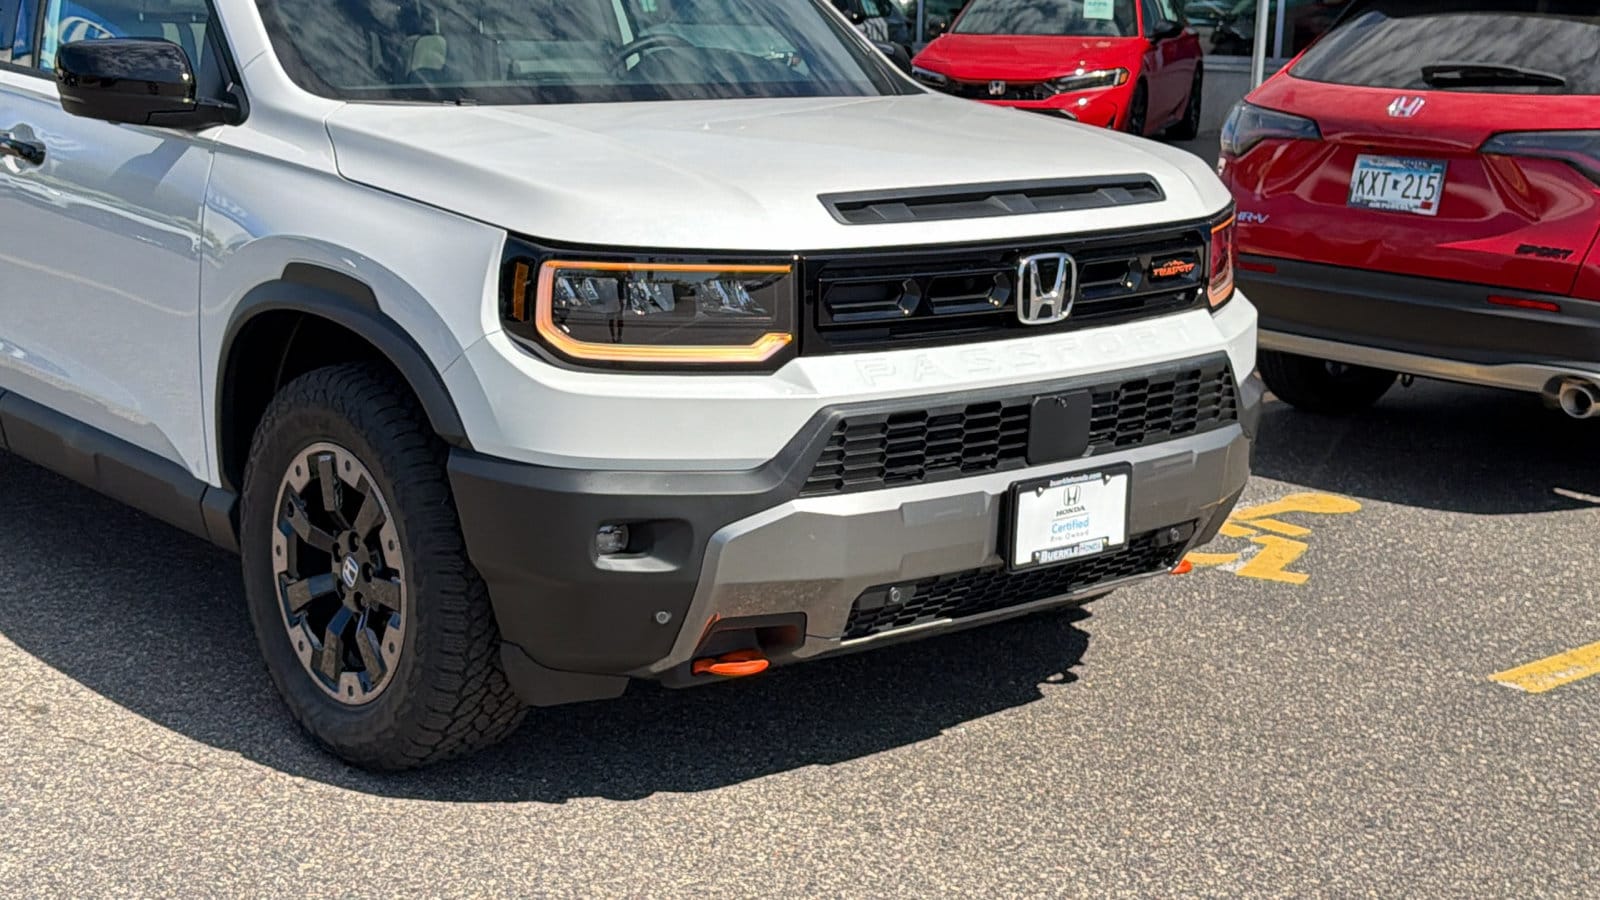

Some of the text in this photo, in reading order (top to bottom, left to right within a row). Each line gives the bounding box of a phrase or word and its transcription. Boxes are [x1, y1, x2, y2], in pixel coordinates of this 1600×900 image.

[1356, 170, 1437, 201] KXT 215
[853, 319, 1192, 386] PASSPORT
[1056, 505, 1085, 516] HONDA
[1052, 517, 1089, 533] Certified
